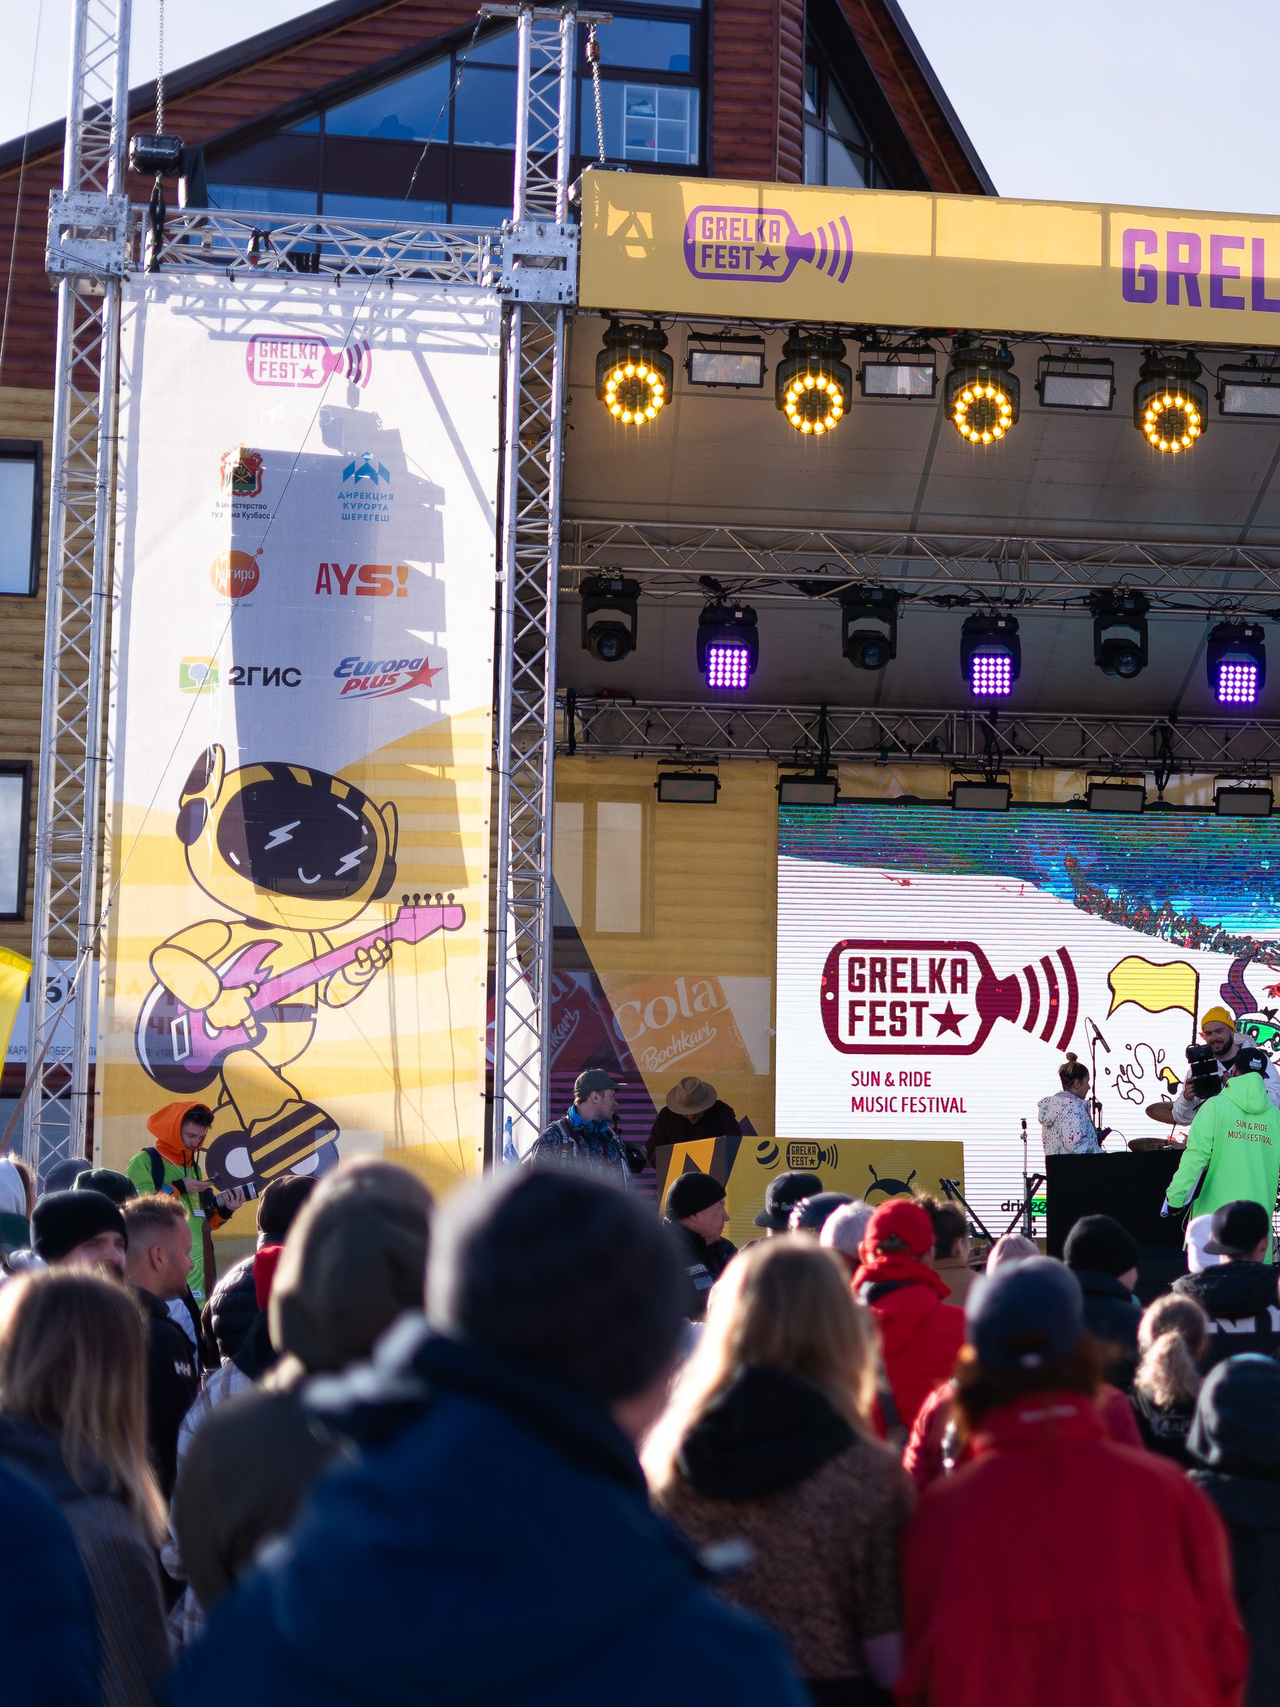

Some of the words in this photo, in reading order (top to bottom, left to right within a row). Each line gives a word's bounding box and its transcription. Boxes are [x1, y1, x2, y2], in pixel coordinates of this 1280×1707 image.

[702, 216, 782, 243] GRELKA
[701, 244, 755, 270] FEST
[259, 340, 318, 360] GRELKA
[259, 361, 299, 379] FEST
[338, 492, 394, 501] ДИРЕКЦИЯ
[343, 502, 389, 511] КУРОРТА
[211, 512, 240, 520] турма
[341, 513, 390, 522] ШЕРЕГЕШ
[315, 563, 409, 597] AYS!
[228, 666, 302, 687] 2ГИС
[848, 957, 968, 994] GRELKA
[613, 976, 720, 1042] Cola
[848, 1001, 930, 1037] FEST
[641, 1021, 716, 1071] Bochkari
[851, 1071, 880, 1087] SUN
[885, 1072, 895, 1087] &
[899, 1071, 932, 1087] RIDE
[851, 1097, 898, 1113] MUSIC
[901, 1097, 967, 1113] FESTIVAL
[1236, 1119, 1247, 1129] SUN
[1248, 1122, 1252, 1130] &
[1254, 1122, 1268, 1132] RIDE
[1228, 1131, 1247, 1140] MUSIC
[1247, 1133, 1272, 1146] FESTIVAL
[791, 1145, 817, 1155] GRELKA
[791, 1156, 809, 1166] FEST
